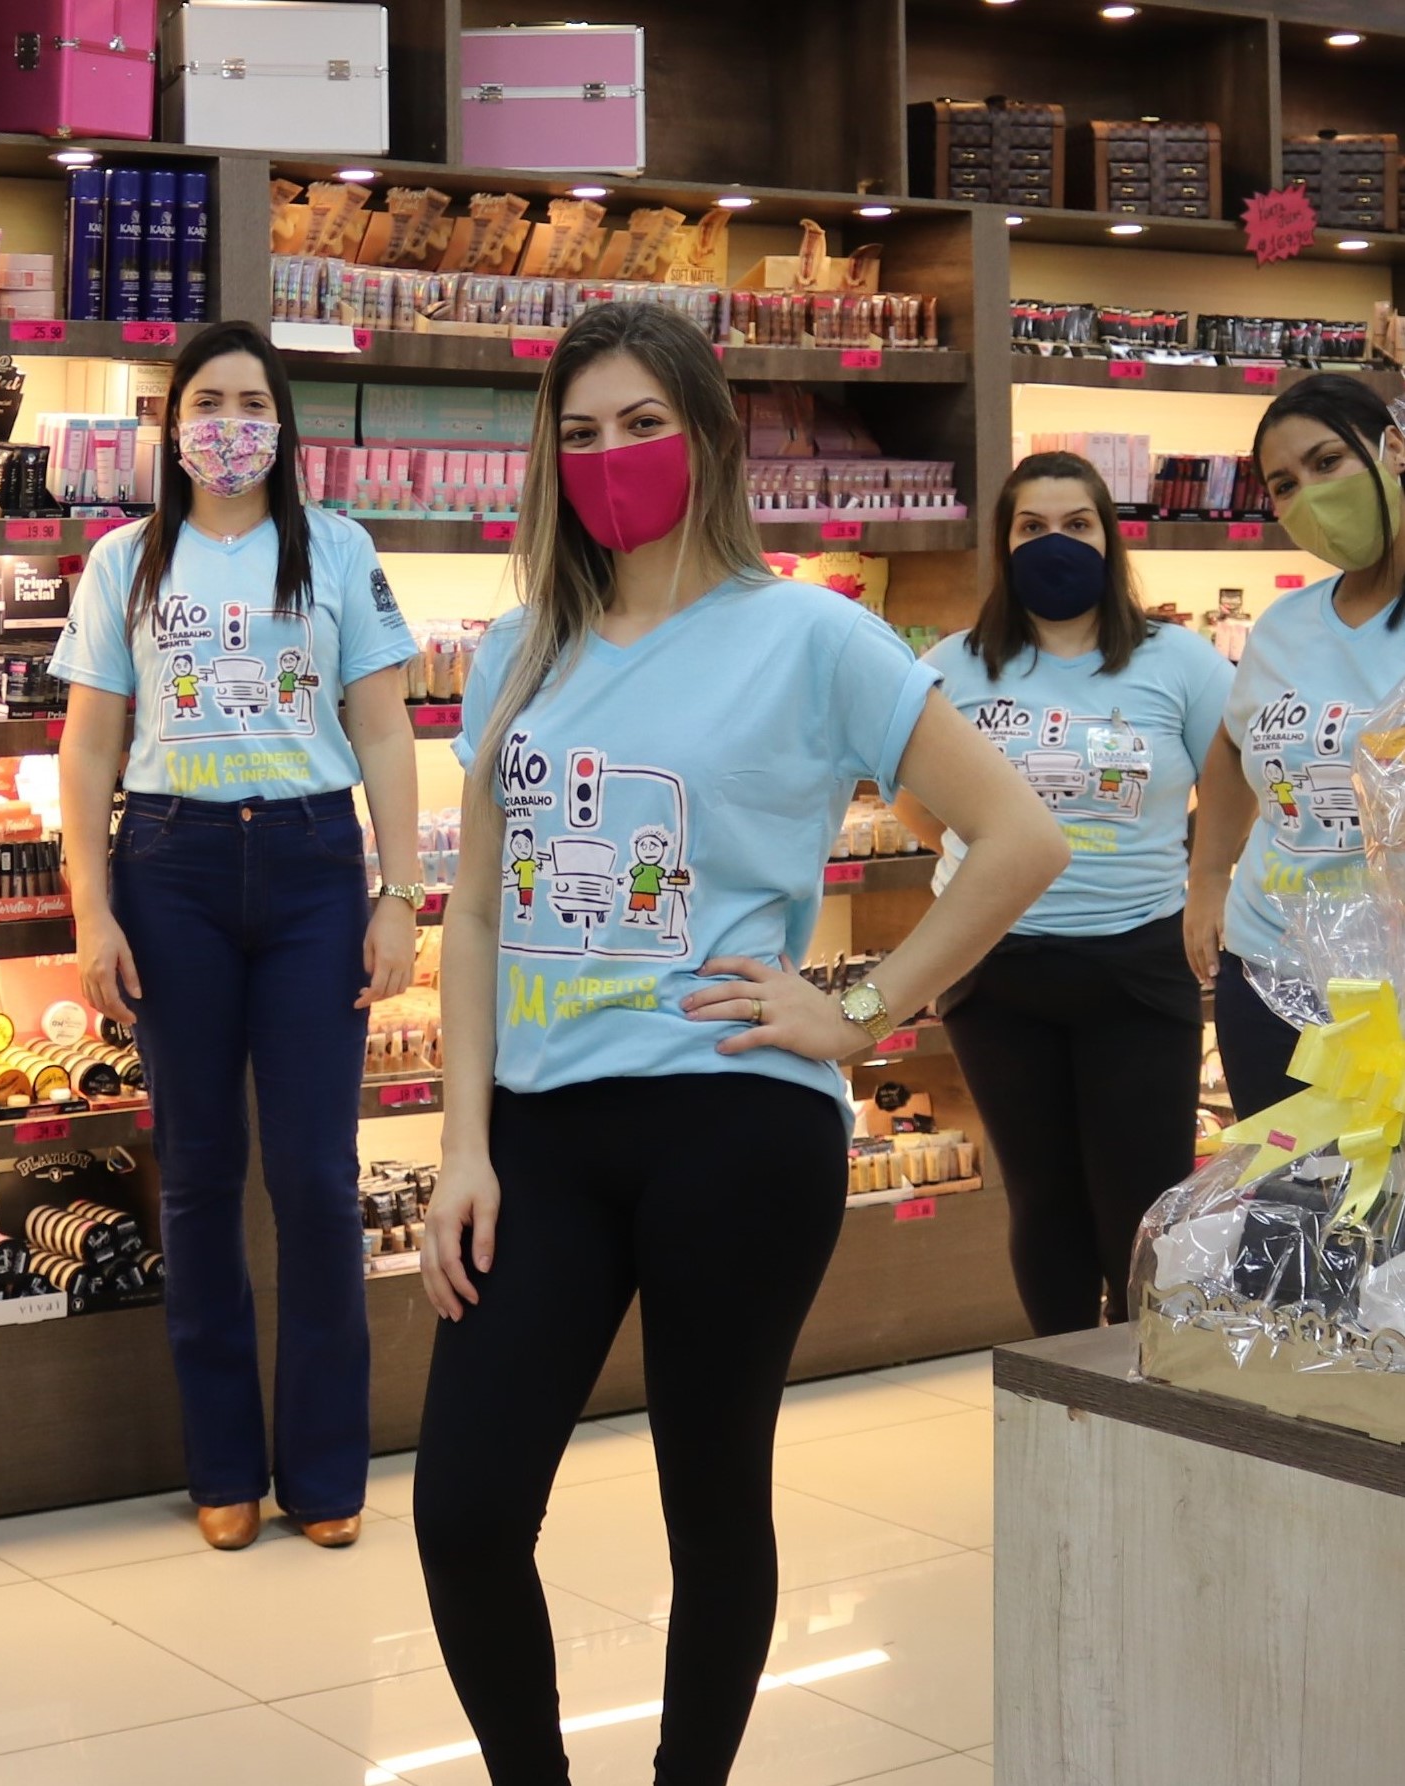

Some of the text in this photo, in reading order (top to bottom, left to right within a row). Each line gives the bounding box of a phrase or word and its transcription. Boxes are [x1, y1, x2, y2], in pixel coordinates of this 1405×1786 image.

[14, 576, 63, 590] Primer
[14, 588, 55, 601] Facial
[152, 595, 207, 638] NÃO
[158, 640, 191, 650] INFANTIL
[168, 630, 212, 640] TRABALHO
[976, 699, 1030, 730] NÃO
[1250, 692, 1307, 733] NÃO
[1261, 733, 1304, 742] TRABALHO
[164, 750, 310, 793] SIM AO DIREITO
[15, 1151, 92, 1178] PLAYBOY
